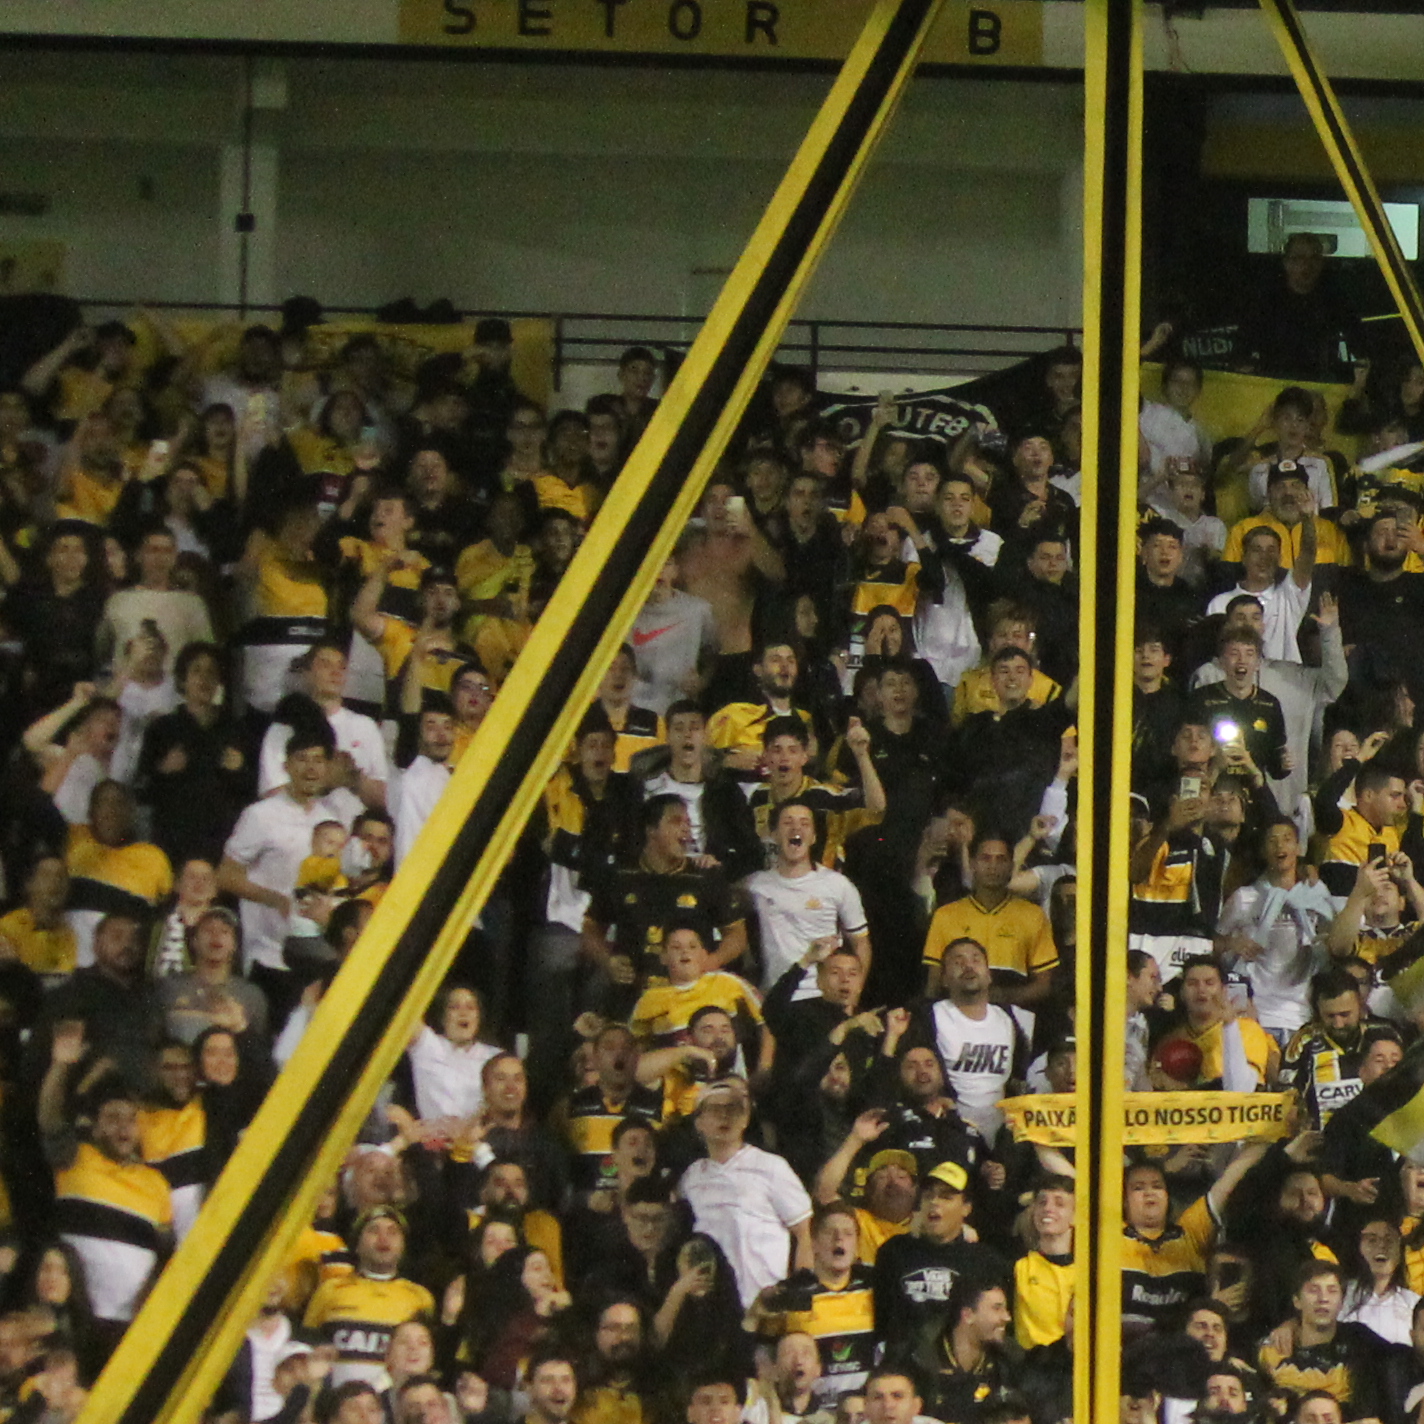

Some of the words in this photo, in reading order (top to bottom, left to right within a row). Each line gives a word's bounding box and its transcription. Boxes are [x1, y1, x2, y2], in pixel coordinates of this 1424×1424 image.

[443, 0, 780, 46] SETOR
[968, 9, 1005, 56] B
[1023, 1107, 1076, 1128] PAIXÃ
[1155, 1106, 1222, 1126] NOSSO
[1227, 1104, 1283, 1124] TIGRE
